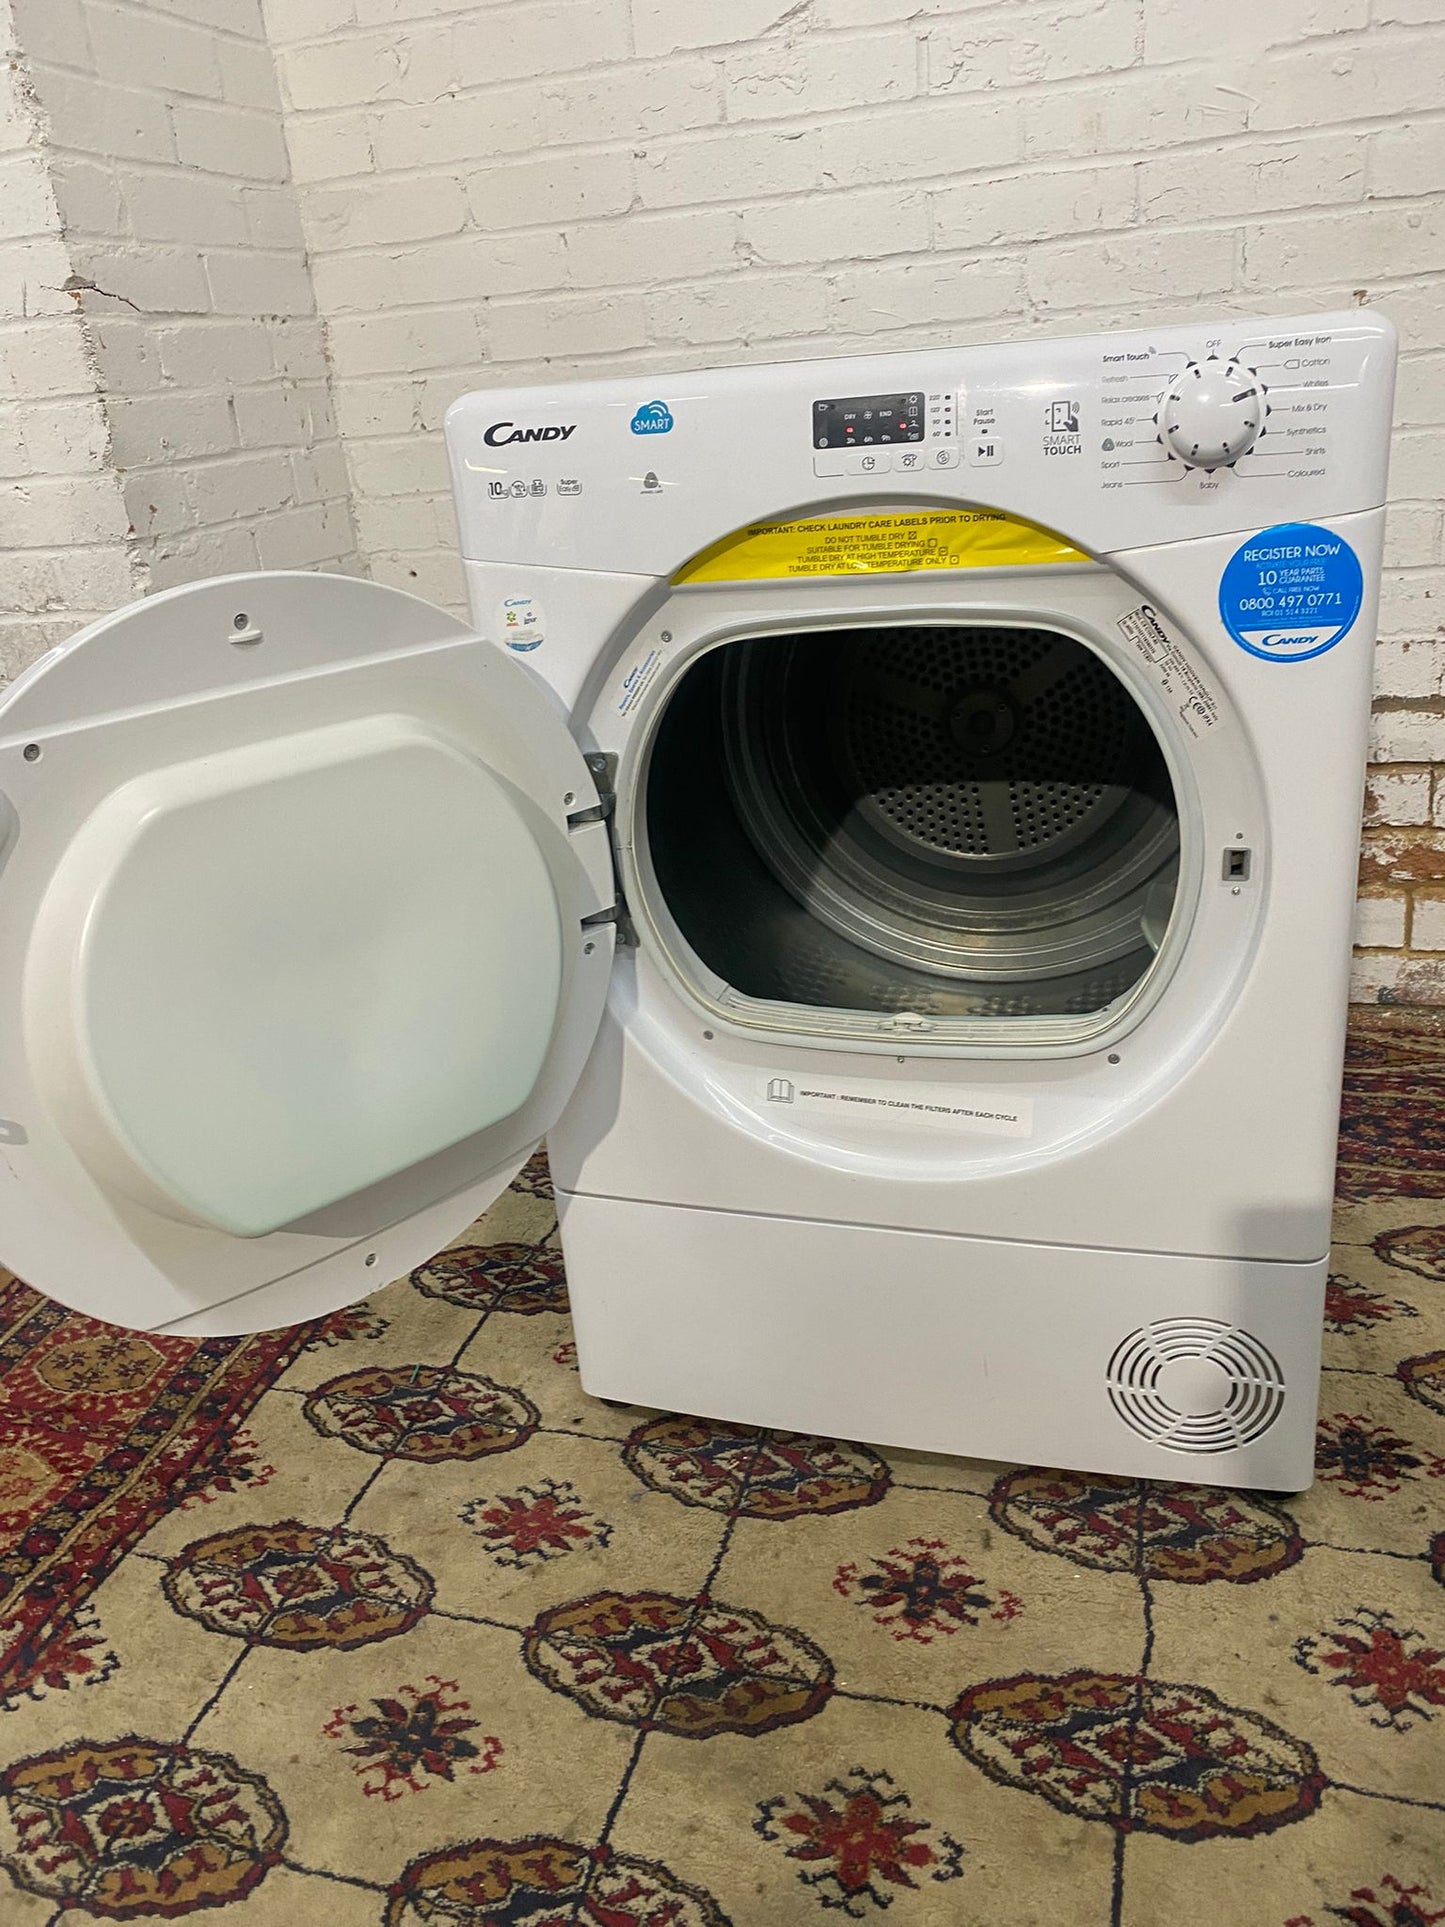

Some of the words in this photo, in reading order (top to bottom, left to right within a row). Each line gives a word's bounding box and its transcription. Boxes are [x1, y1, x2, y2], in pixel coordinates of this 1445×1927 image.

[1206, 339, 1221, 348] OFF
[1268, 340, 1292, 349] Super
[1294, 337, 1314, 347] Easy
[1315, 336, 1331, 344] Iron
[1102, 354, 1125, 363] Smart
[1126, 353, 1150, 361] Touch
[1301, 358, 1330, 368] Cotton
[976, 408, 994, 416] Start
[1313, 402, 1328, 412] Dry
[634, 417, 670, 431] SMART
[973, 417, 996, 425] Pause
[1101, 418, 1123, 427] Rapid
[484, 422, 577, 447] CANDY
[1286, 426, 1327, 437] Synthetics
[1042, 434, 1082, 446] SMART
[1116, 440, 1134, 448] Wool
[1043, 445, 1082, 456] TOUCH
[1101, 461, 1120, 469] Sport
[1287, 468, 1326, 478] Coloured
[1101, 481, 1123, 489] Jeans
[1199, 481, 1219, 490] Baby
[748, 525, 796, 536] IMPORTANT:
[797, 523, 826, 533] CHECK
[828, 520, 866, 531] LAUNDRY
[868, 519, 892, 529] CARE
[894, 517, 928, 526] LABELS
[929, 515, 957, 524] PRIOR
[958, 514, 970, 523] TO
[973, 513, 1006, 522] DRYING
[824, 536, 837, 544] DO
[839, 535, 856, 543] NOT
[857, 533, 887, 542] TUMBLE
[889, 532, 905, 540] DRY
[806, 544, 842, 554] SUITABLE
[844, 543, 860, 552] FOR
[862, 541, 893, 551] TUMBLE
[894, 540, 926, 549] DRYING
[1243, 546, 1302, 561] REGISTER
[1305, 543, 1342, 557] NOW
[797, 554, 828, 563] TUMBLE
[829, 554, 844, 562] DRY
[857, 552, 876, 560] HIGH
[878, 548, 936, 559] TEMPERATURE
[788, 564, 818, 573] TUMBLE
[820, 563, 835, 571] DRY
[836, 562, 845, 570] AT
[868, 558, 924, 568] TEMPERATURE
[925, 556, 947, 565] ONLY
[1279, 567, 1300, 577] YEAR
[1301, 566, 1325, 575] PARTS
[1258, 570, 1278, 586] 10
[1279, 574, 1326, 584] GUARANTEE
[1239, 597, 1274, 611] 0800
[1279, 594, 1304, 608] 497
[1307, 592, 1342, 607] 0771
[1141, 605, 1171, 643] CANDY
[1262, 634, 1319, 646] CANDY
[800, 1090, 836, 1100] IMPORTANT
[840, 1094, 876, 1105] REMEMBER
[887, 1100, 910, 1109] CLEAN
[925, 1105, 951, 1114] FILTERS
[952, 1108, 974, 1117] AFTER
[975, 1111, 994, 1119] EACH
[995, 1113, 1018, 1122] CYCLE
